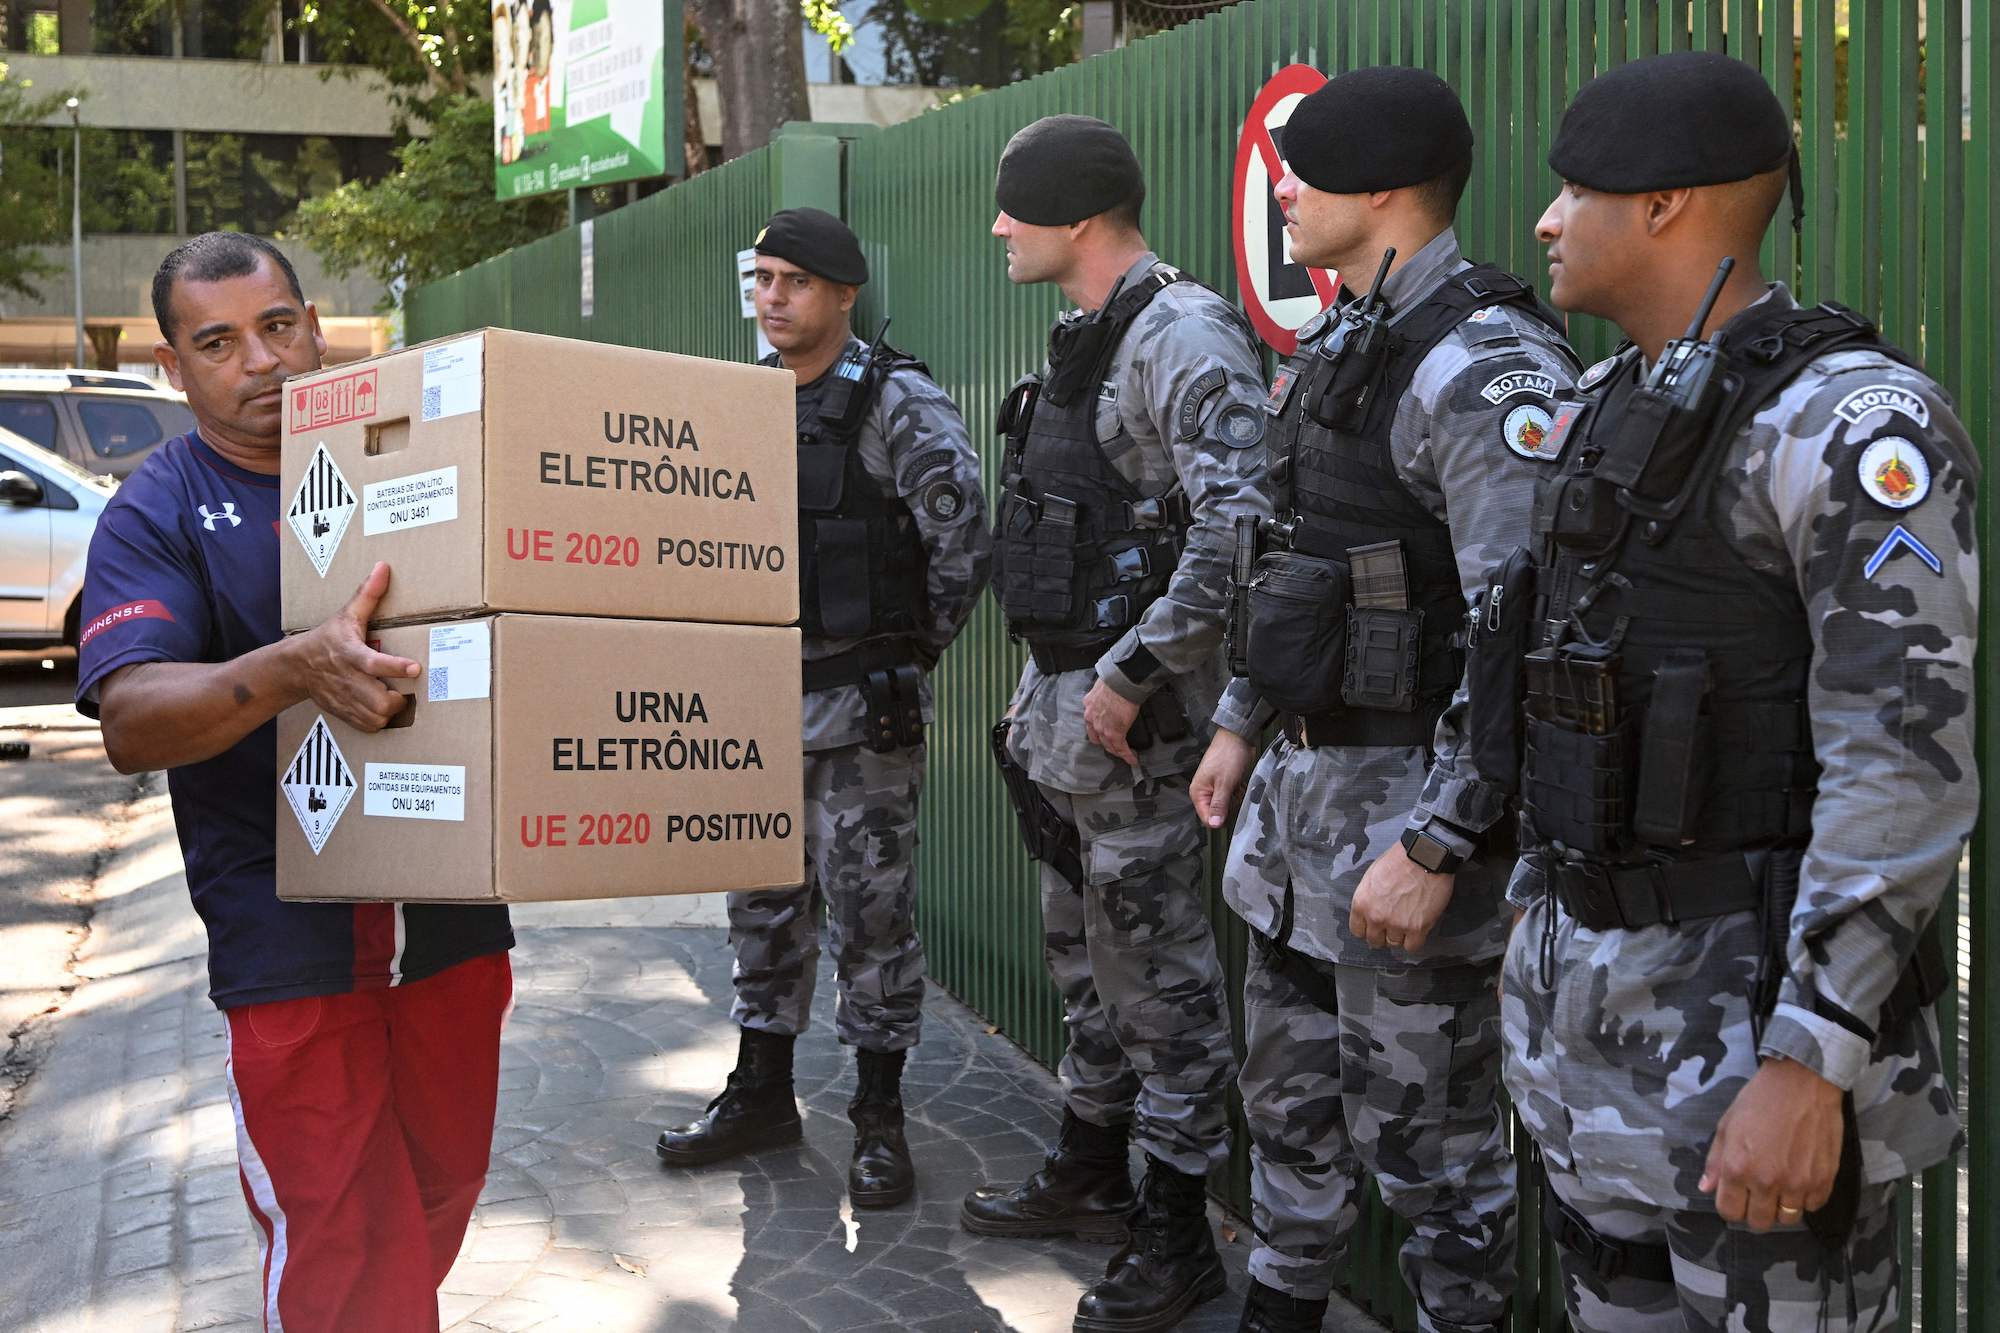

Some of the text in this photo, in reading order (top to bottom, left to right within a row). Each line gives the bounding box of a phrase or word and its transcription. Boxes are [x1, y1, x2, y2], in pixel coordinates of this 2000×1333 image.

[1489, 376, 1549, 399] ROTAM
[316, 390, 329, 410] 08
[1183, 377, 1213, 424] ROTAM
[1848, 392, 1919, 414] ROTAM
[604, 411, 699, 452] URNA
[540, 451, 755, 502] ELETRÔNICA
[367, 486, 453, 511] CONTIDAS EM EQUIPAMENTOS
[377, 485, 405, 498] BATERIAS
[406, 483, 414, 492] DE
[390, 505, 430, 524] ONU 3481
[507, 528, 785, 572] UE 2020 POSITIVO
[615, 691, 708, 723] URNA
[553, 729, 764, 770] ELETRÔNICA
[379, 771, 409, 781] BATERIAS
[411, 772, 419, 781] DE
[368, 782, 461, 795] CONTIDAS EM EQUIPAMENTOS
[392, 797, 435, 812] ONU 3481
[520, 812, 792, 848] UE 2020 POSITIVO
